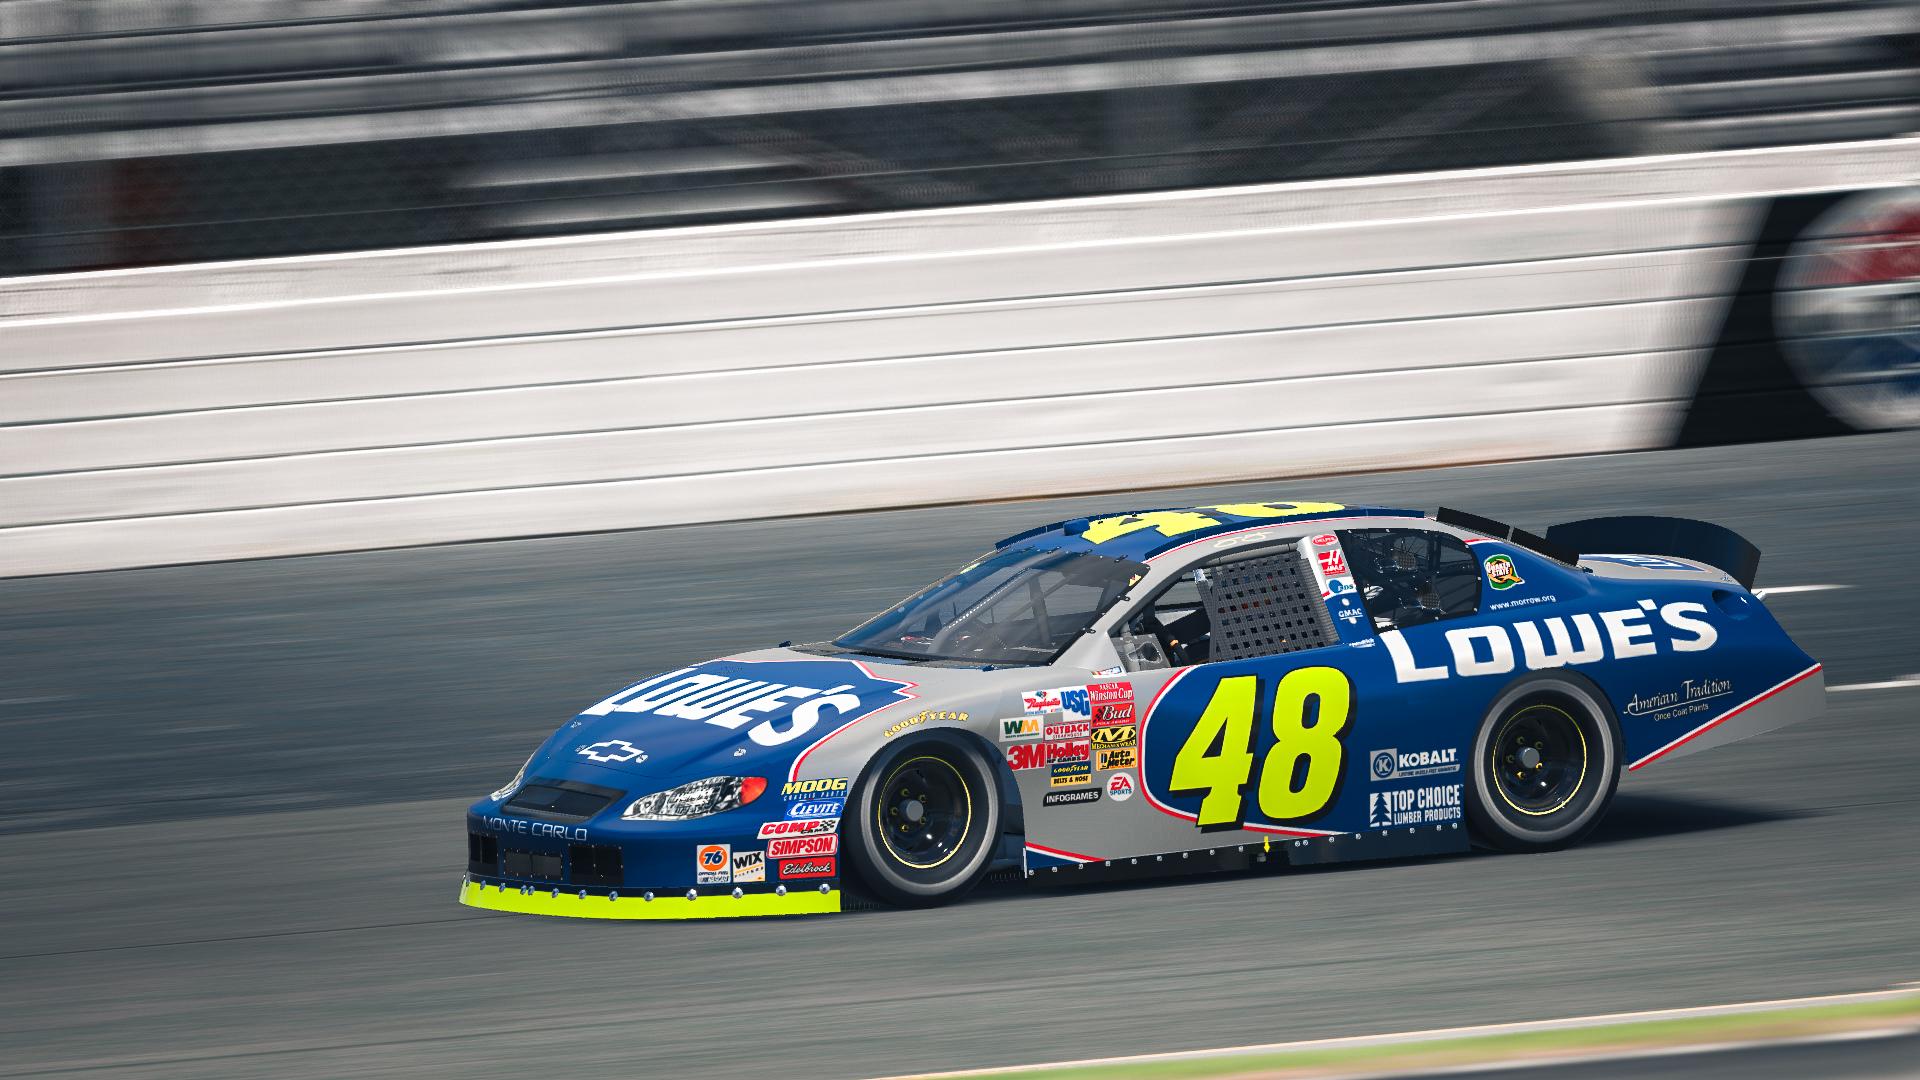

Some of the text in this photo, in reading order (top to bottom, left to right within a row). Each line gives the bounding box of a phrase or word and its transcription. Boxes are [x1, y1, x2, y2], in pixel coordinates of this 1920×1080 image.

[1338, 607, 1362, 618] GMAC
[1378, 598, 1719, 684] LOWE'S
[1060, 689, 1091, 716] USG
[1089, 687, 1133, 702] Winston Cup
[1624, 678, 1732, 715] American Tradition
[578, 664, 861, 747] LOWE'S
[1102, 704, 1133, 721] Bud
[1689, 702, 1709, 714] Paints
[1003, 718, 1040, 735] WM
[1045, 723, 1089, 736] OUTBACK
[1046, 742, 1090, 760] Holley
[1110, 749, 1131, 759] Auto
[1167, 665, 1353, 829] 48
[1007, 743, 1046, 770] 3M
[1107, 757, 1135, 767] Meter
[1398, 748, 1457, 768] KOBALT
[781, 777, 849, 796] MOOG
[1110, 776, 1132, 790] EA
[1046, 791, 1099, 804] INFOGRAMES
[1109, 788, 1133, 796] SPORTS
[1391, 784, 1461, 812] TOP CHOICE
[789, 802, 840, 817] CLEVITE
[1393, 806, 1461, 826] LUMBER PRODUCTS
[482, 815, 588, 841] MONTE CARLO
[761, 820, 821, 835] COMP
[771, 836, 834, 856] SIMPSON
[703, 849, 724, 865] 76
[733, 851, 763, 869] WIX
[782, 861, 832, 876] Edelbrock
